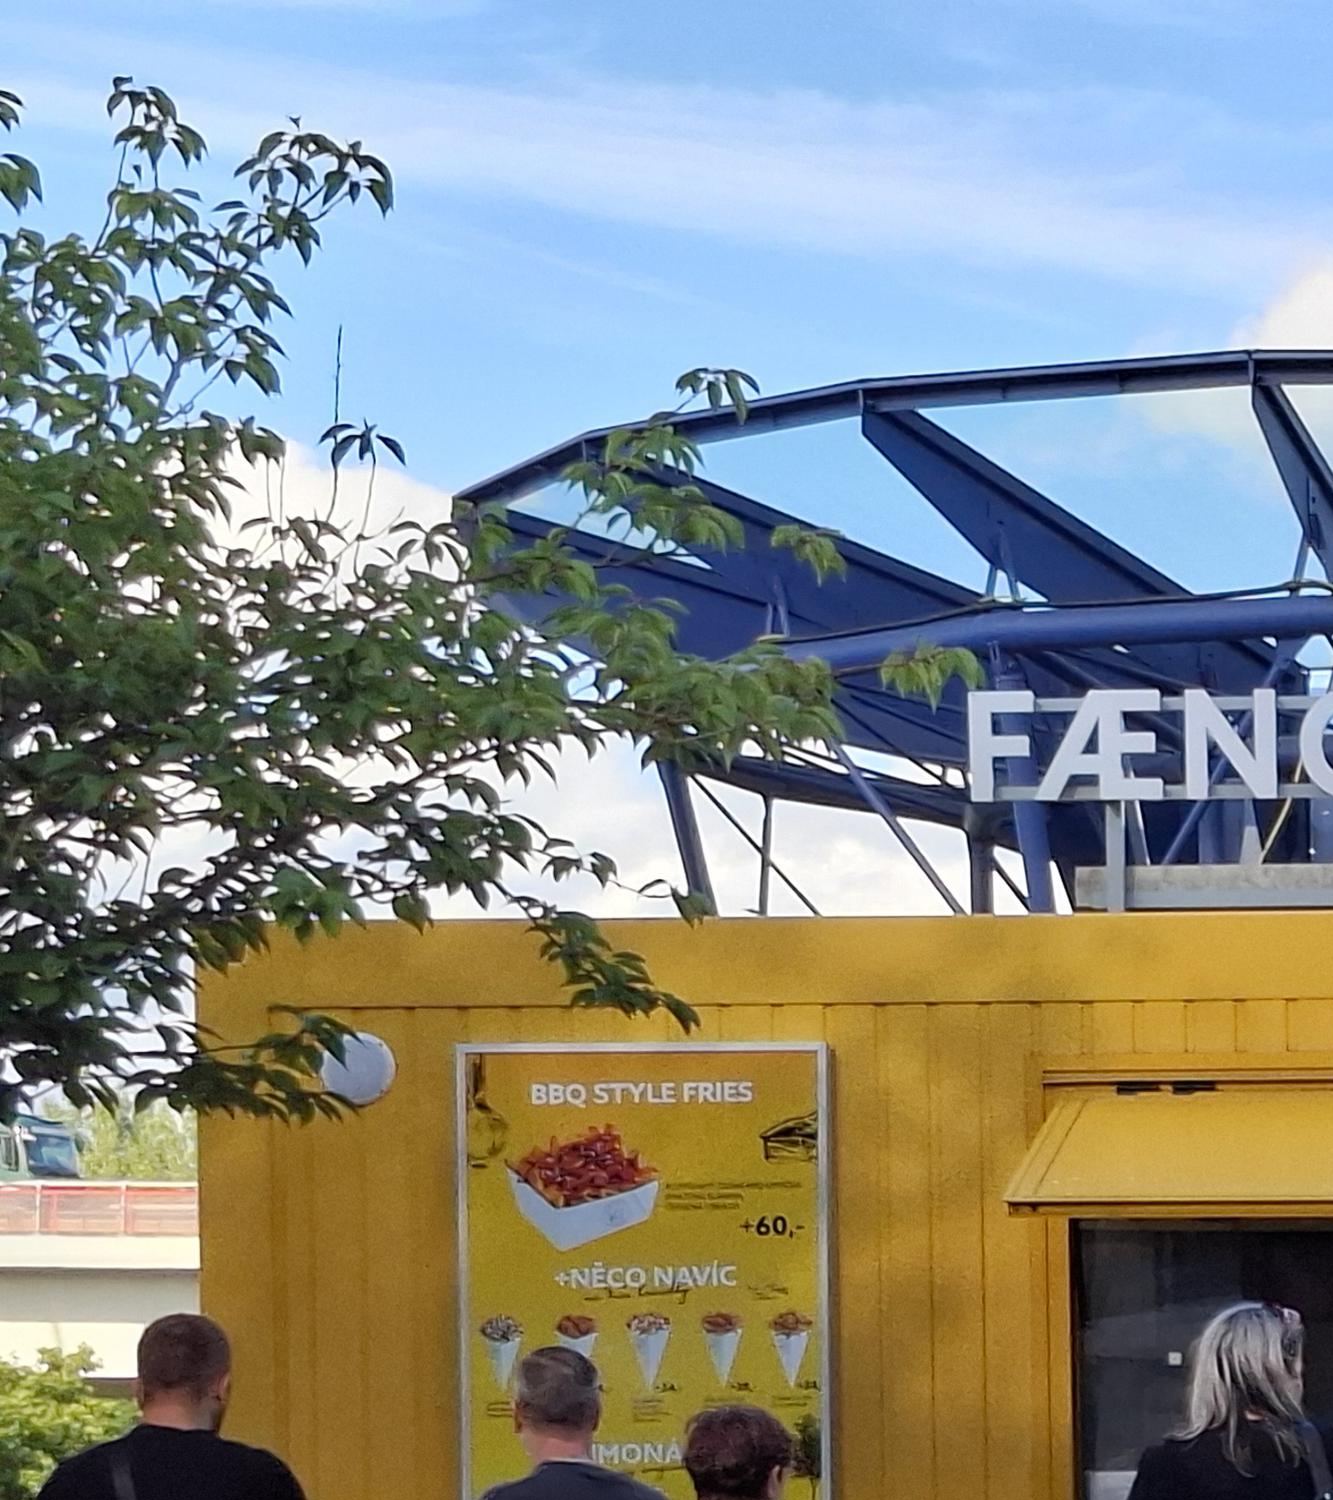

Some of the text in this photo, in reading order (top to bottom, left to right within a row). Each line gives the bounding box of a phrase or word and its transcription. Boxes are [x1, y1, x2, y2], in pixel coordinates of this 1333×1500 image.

[531, 1080, 753, 1108] BBQ STYLE FRIES
[739, 1214, 806, 1239] +60,-
[653, 1259, 737, 1287] NAVÍC
[591, 1437, 683, 1464] IMONÁ
